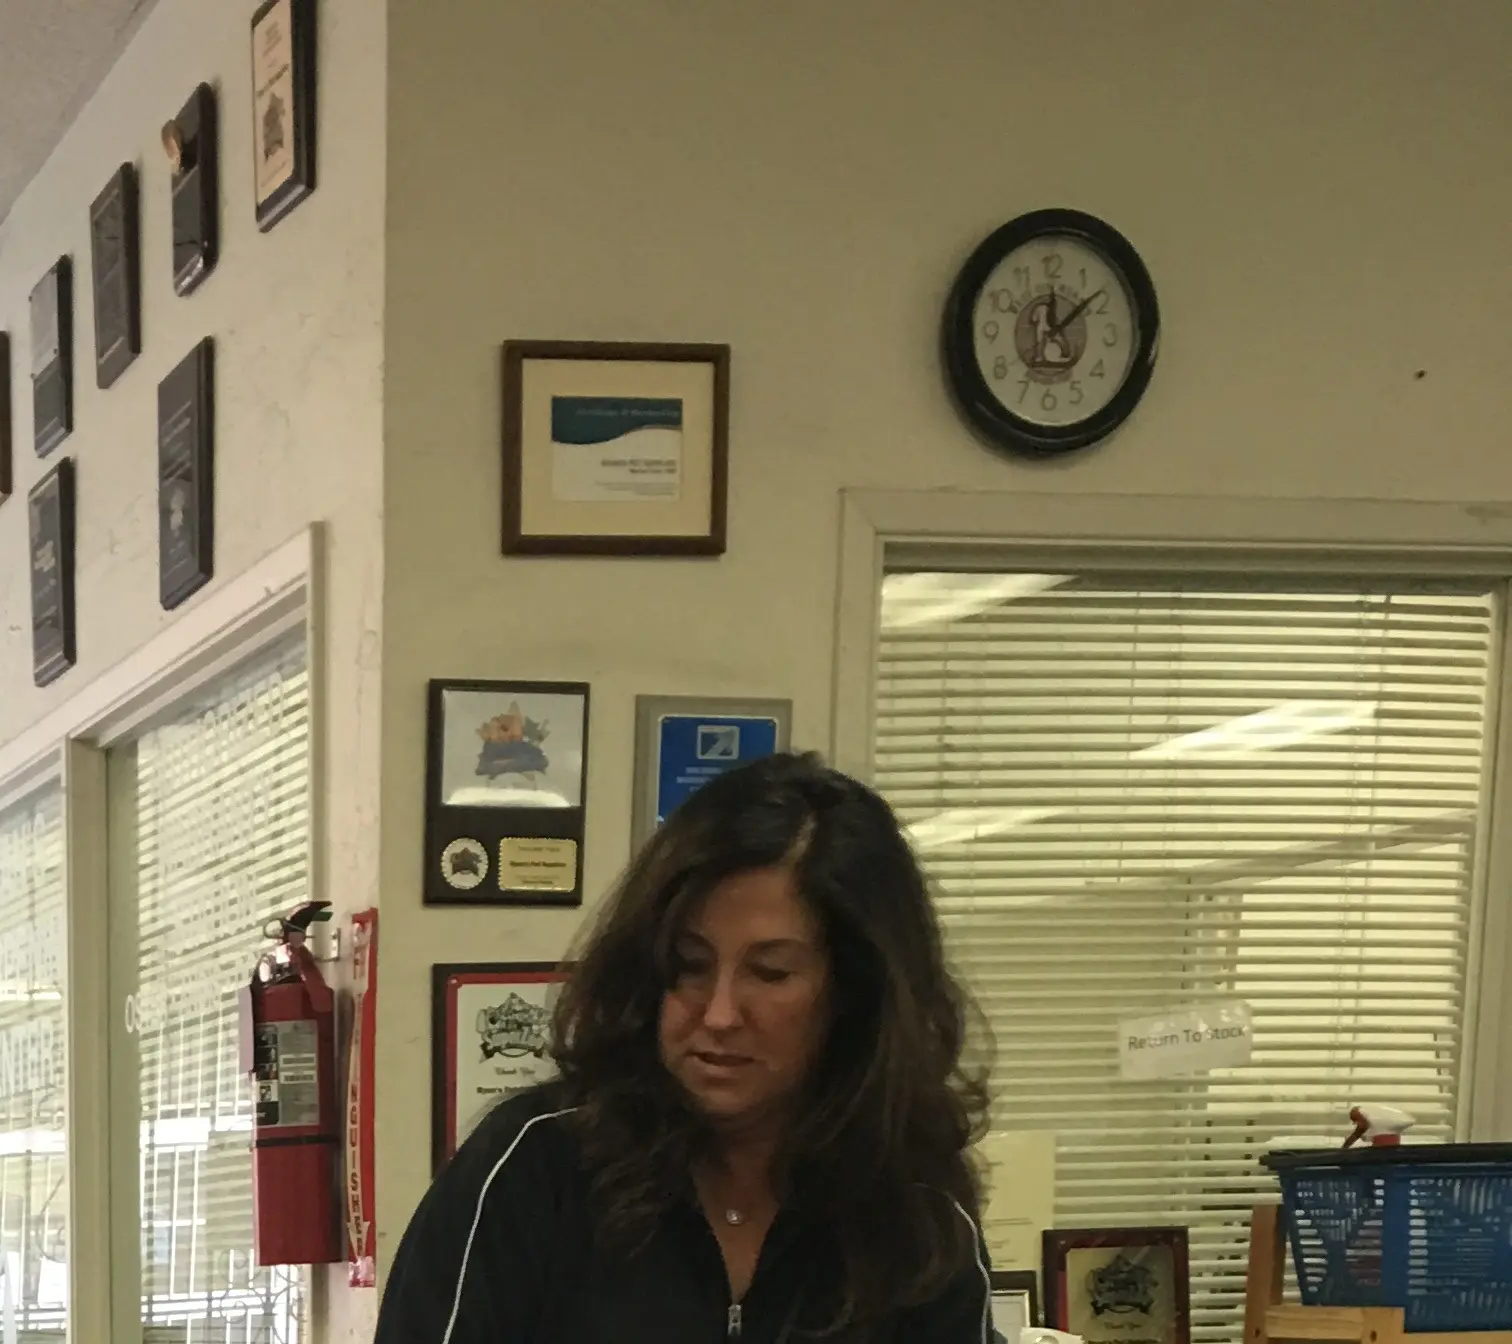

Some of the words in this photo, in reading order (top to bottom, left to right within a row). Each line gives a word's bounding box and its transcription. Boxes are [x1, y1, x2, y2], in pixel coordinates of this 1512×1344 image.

[1041, 254, 1063, 279] 12
[989, 288, 1016, 314] 10
[983, 320, 1000, 345] 9
[1102, 322, 1118, 347] 3
[993, 355, 1009, 380] 8
[1089, 358, 1105, 379] 4
[1017, 380, 1030, 404] 7
[1040, 387, 1058, 411] 6
[1069, 380, 1084, 404] 5
[1128, 1034, 1179, 1050] Return
[1183, 1028, 1202, 1043] To
[1207, 1026, 1245, 1040] Stock
